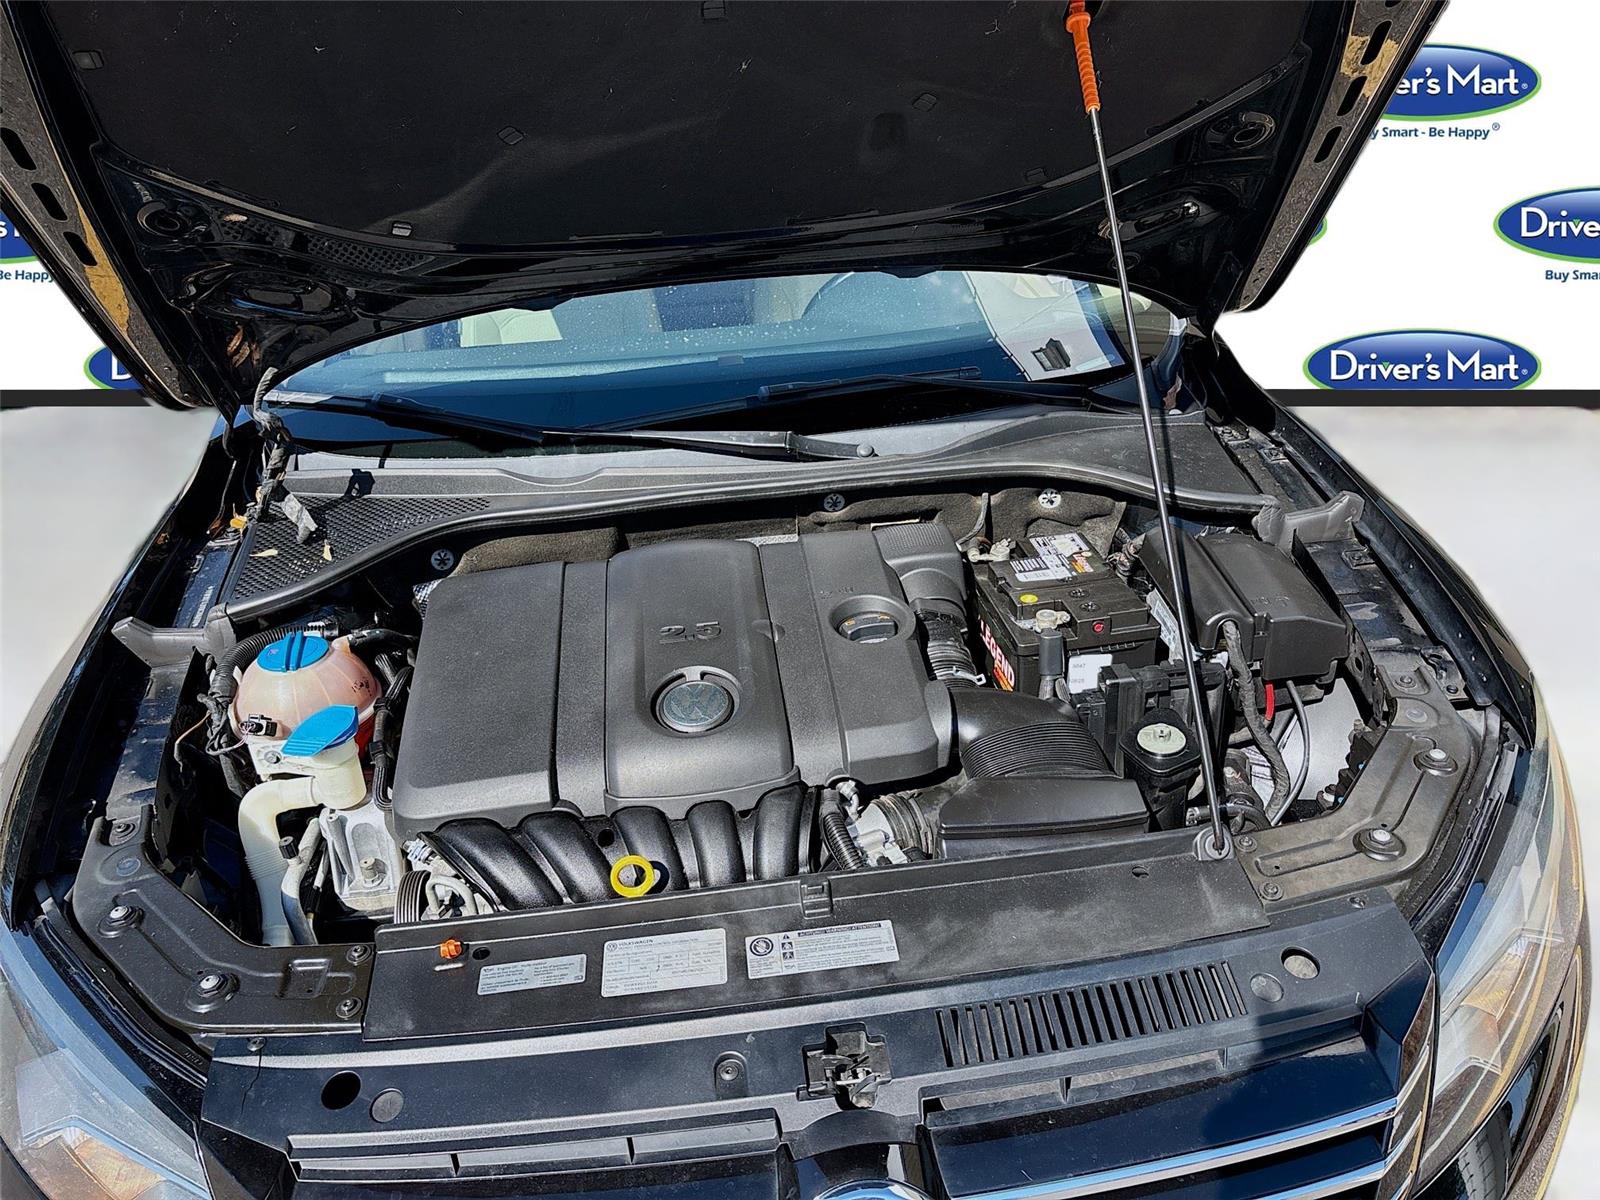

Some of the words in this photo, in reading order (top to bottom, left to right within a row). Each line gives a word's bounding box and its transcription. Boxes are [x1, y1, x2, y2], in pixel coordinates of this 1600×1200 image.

[1396, 67, 1441, 95] er's
[1447, 64, 1519, 94] Mart
[1382, 127, 1419, 137] Smart
[1429, 127, 1445, 137] Be
[1448, 127, 1490, 140] Happy
[1521, 206, 1600, 238] Drive
[1545, 269, 1570, 283] Buy
[1572, 269, 1600, 280] Sma
[1330, 350, 1441, 380] Driver's
[1447, 350, 1519, 380] Mart
[659, 621, 722, 645] 2.5
[979, 618, 1016, 689] LEGEND
